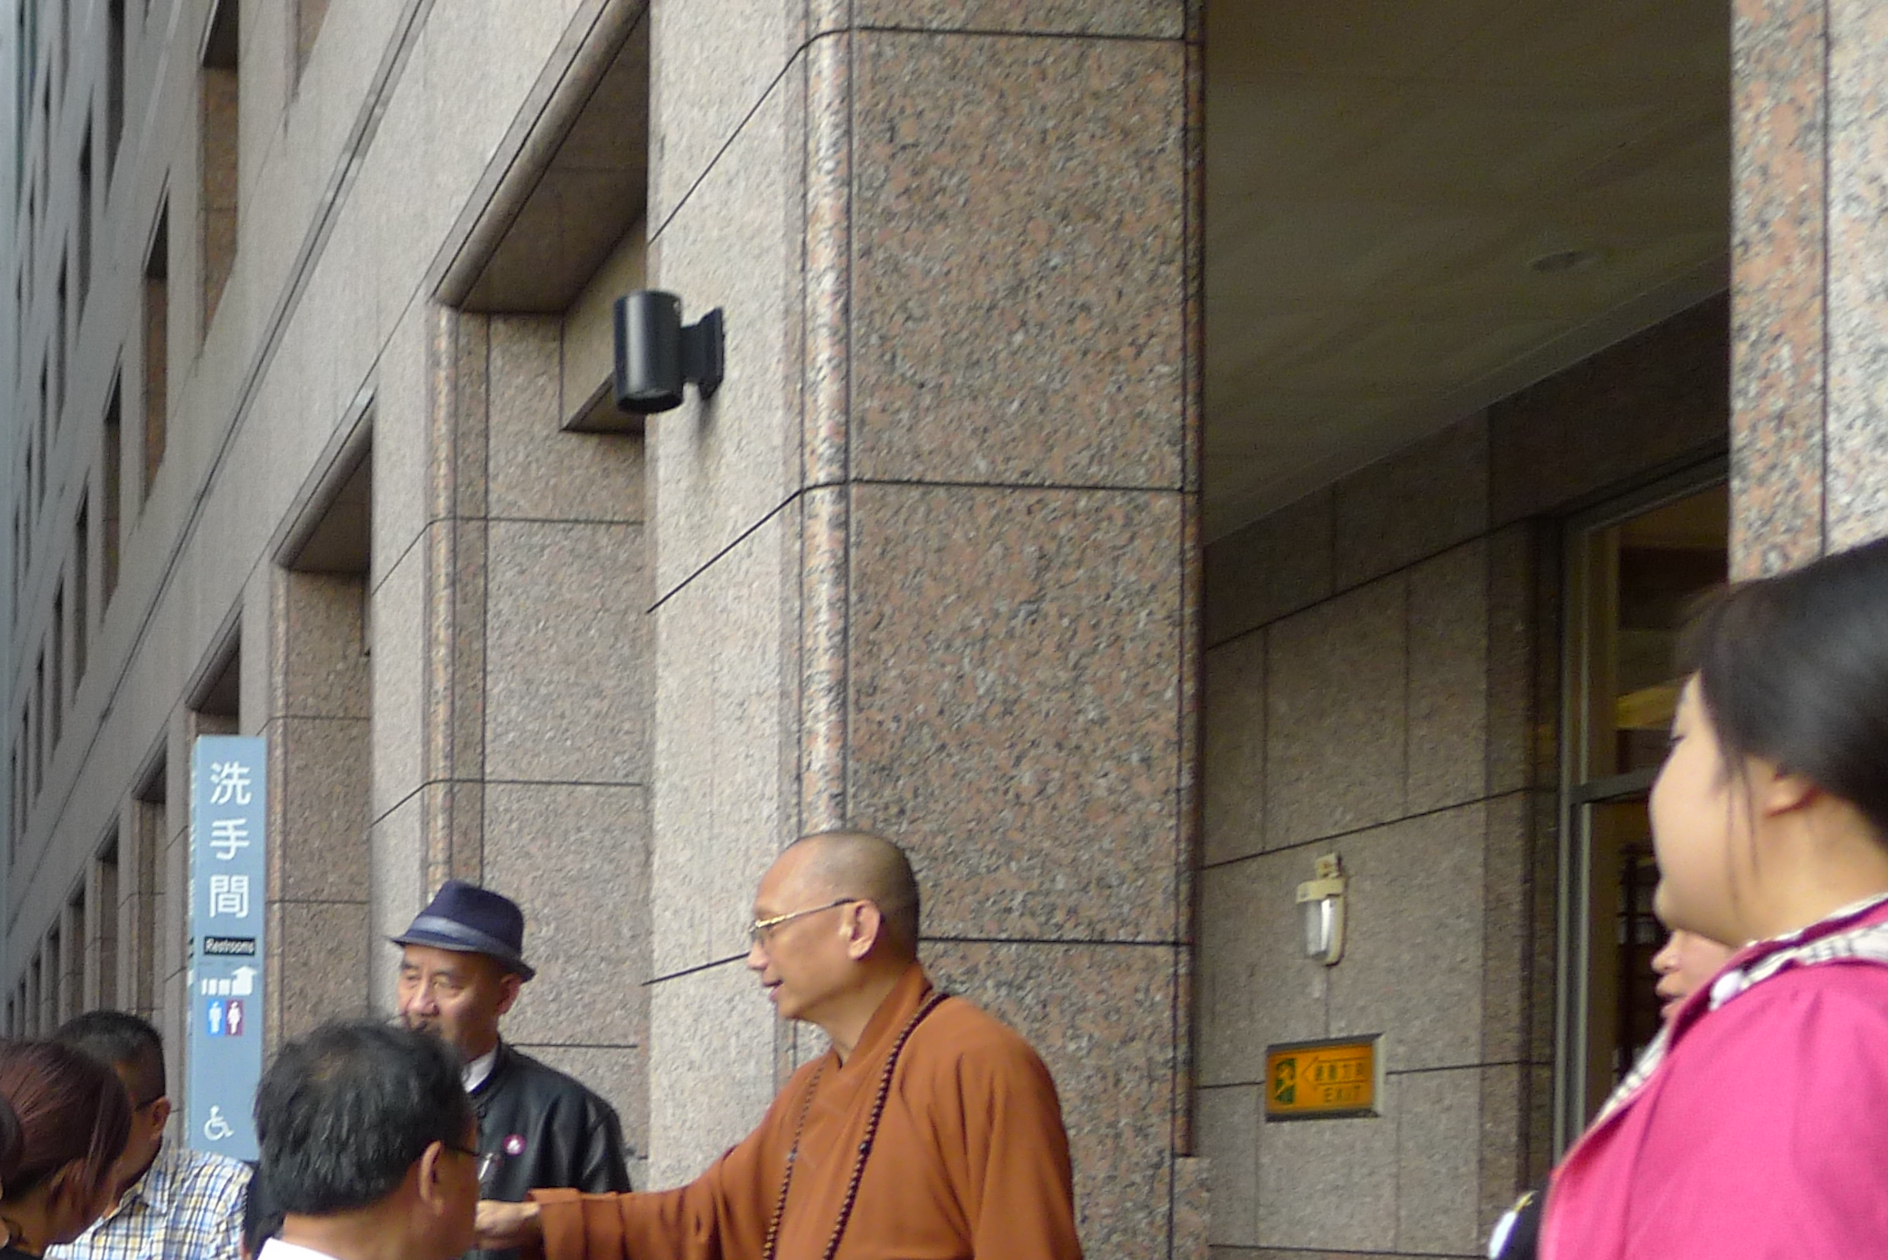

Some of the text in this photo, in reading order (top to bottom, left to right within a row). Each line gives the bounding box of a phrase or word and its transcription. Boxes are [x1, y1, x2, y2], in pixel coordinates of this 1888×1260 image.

[208, 761, 252, 919] 洗手間
[205, 937, 255, 954] Restrooms
